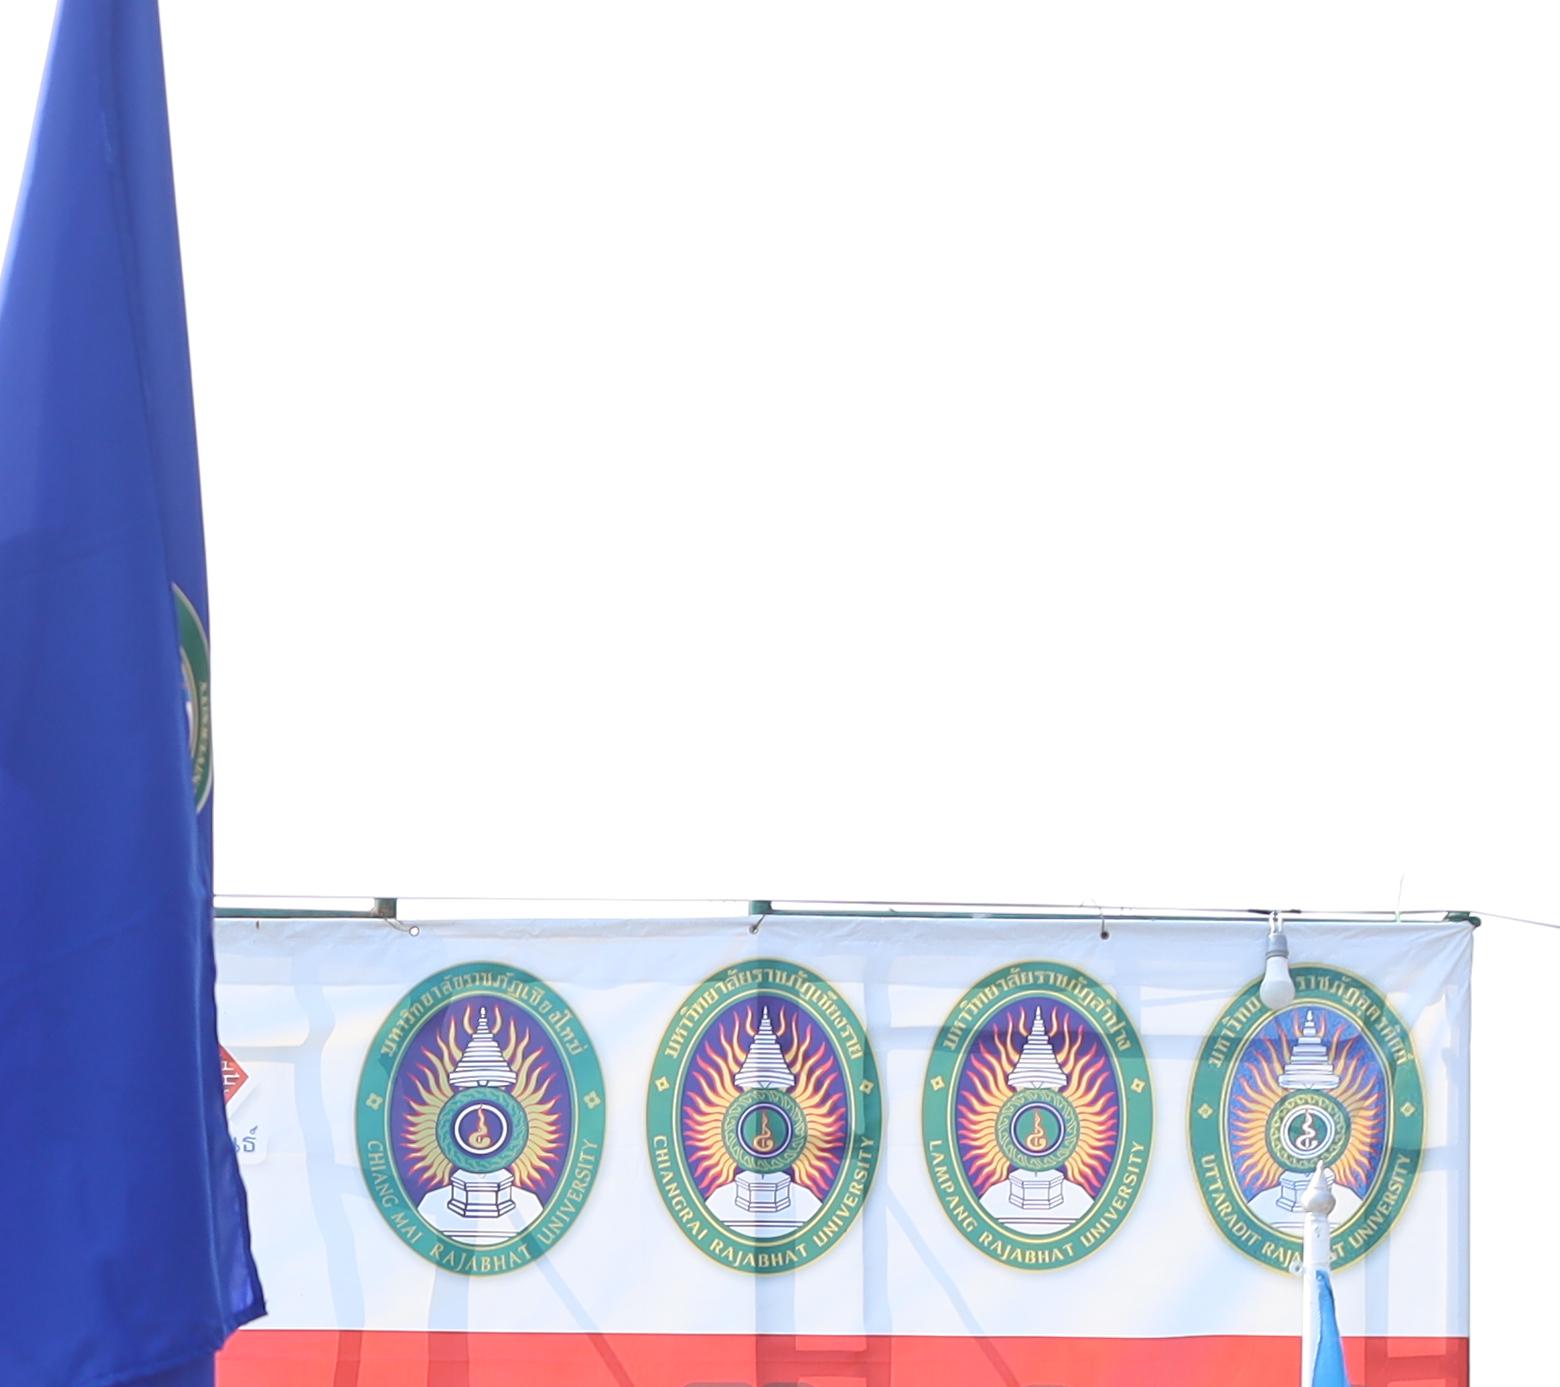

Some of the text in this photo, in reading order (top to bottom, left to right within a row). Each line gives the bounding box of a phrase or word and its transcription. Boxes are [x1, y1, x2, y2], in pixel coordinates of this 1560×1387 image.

[365, 1137, 599, 1275] CHIANG MAI RAJABHAT UNIVERSITY
[652, 1134, 876, 1269] CHIANGRAI RAJABHAT UNIVERSITY
[927, 1138, 1144, 1263] LAMPANG RAJABHAT UNIVERSITY
[1200, 1153, 1261, 1249] UTTARADIT
[1348, 1152, 1412, 1249] UNIVERSITY
